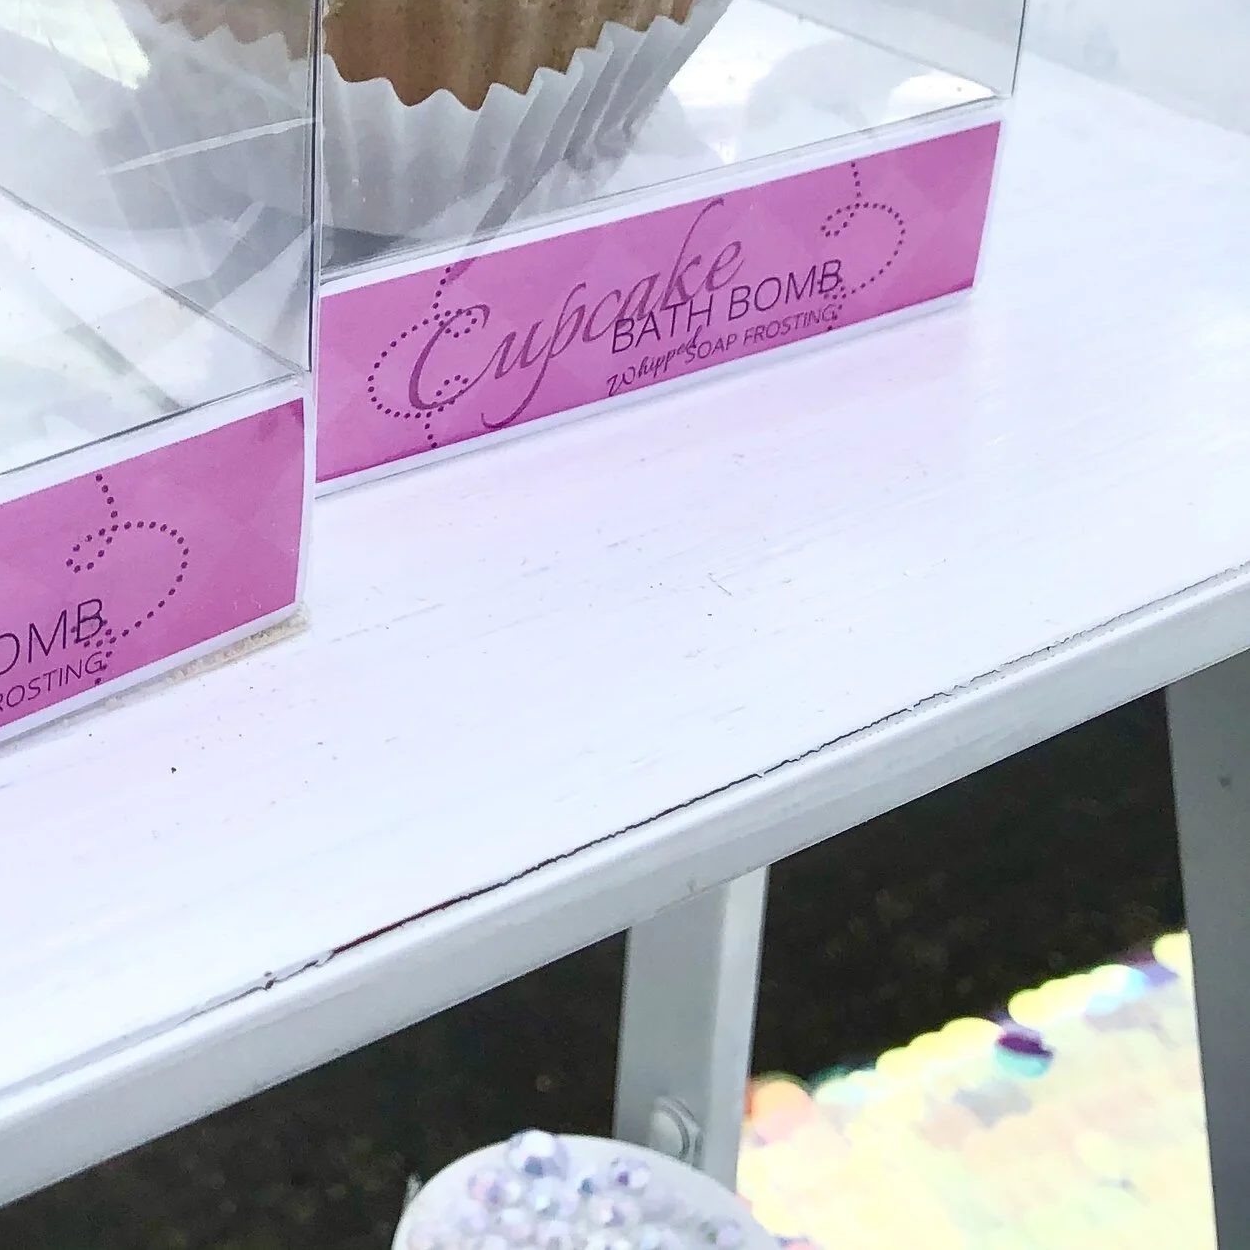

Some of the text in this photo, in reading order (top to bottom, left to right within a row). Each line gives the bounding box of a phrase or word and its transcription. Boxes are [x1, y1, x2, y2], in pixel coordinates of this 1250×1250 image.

[408, 197, 745, 429] Cupcake
[606, 303, 838, 398] Whipped SOAP FROSTING
[611, 258, 843, 355] BATH BOMB
